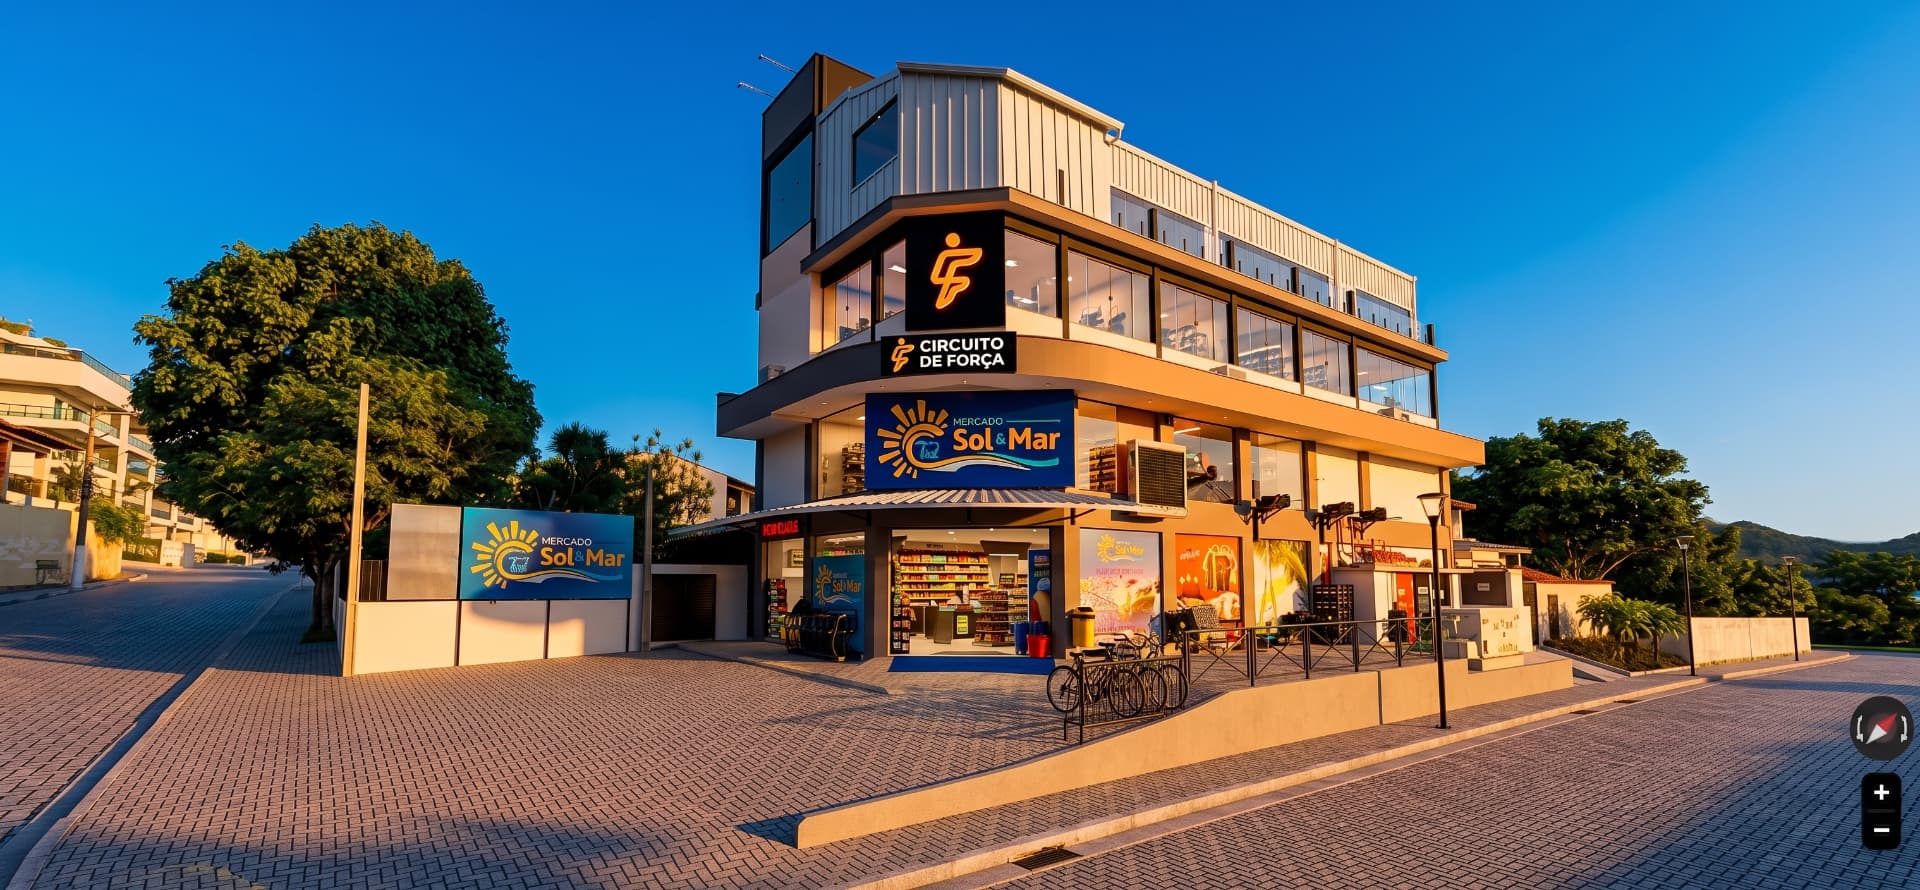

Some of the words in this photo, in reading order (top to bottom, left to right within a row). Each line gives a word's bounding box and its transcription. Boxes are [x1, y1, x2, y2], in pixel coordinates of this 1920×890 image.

[920, 337, 1004, 352] CIRCUITO
[920, 355, 942, 368] DE
[947, 353, 1005, 369] FORÇA
[953, 418, 1003, 426] MERCADO
[953, 427, 993, 451] Sol
[995, 433, 1006, 445] &
[1008, 427, 1060, 450] Mar
[541, 537, 592, 546] MERCADO
[540, 547, 575, 566] Sol
[575, 551, 584, 562] &
[585, 549, 625, 566] Mar
